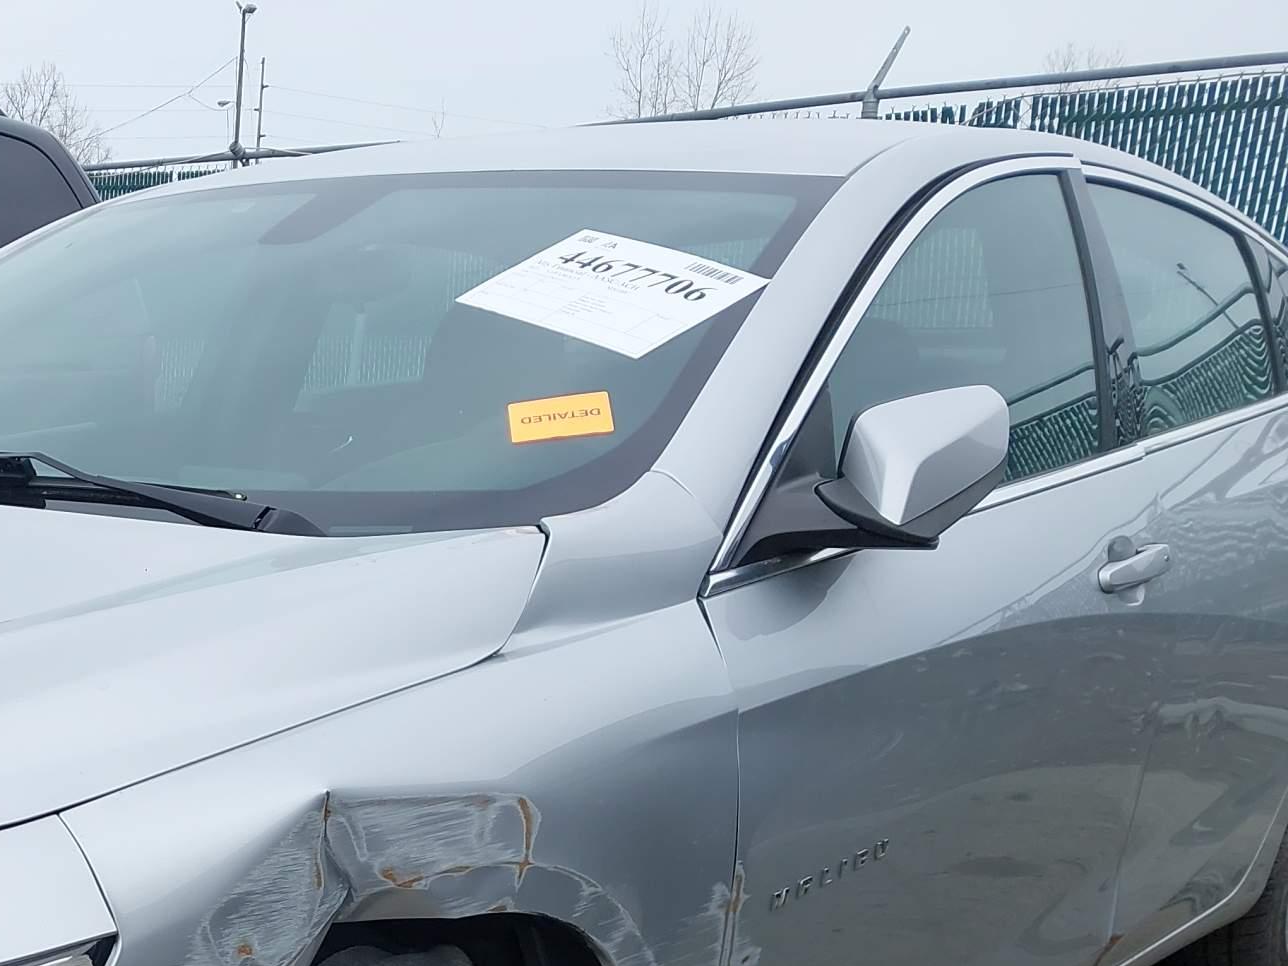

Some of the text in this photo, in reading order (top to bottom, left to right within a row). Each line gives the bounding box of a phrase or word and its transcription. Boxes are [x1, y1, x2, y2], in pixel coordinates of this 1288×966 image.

[558, 251, 717, 301] 44677706
[520, 407, 601, 425] DETAILED
[769, 838, 889, 912] MALIBU
